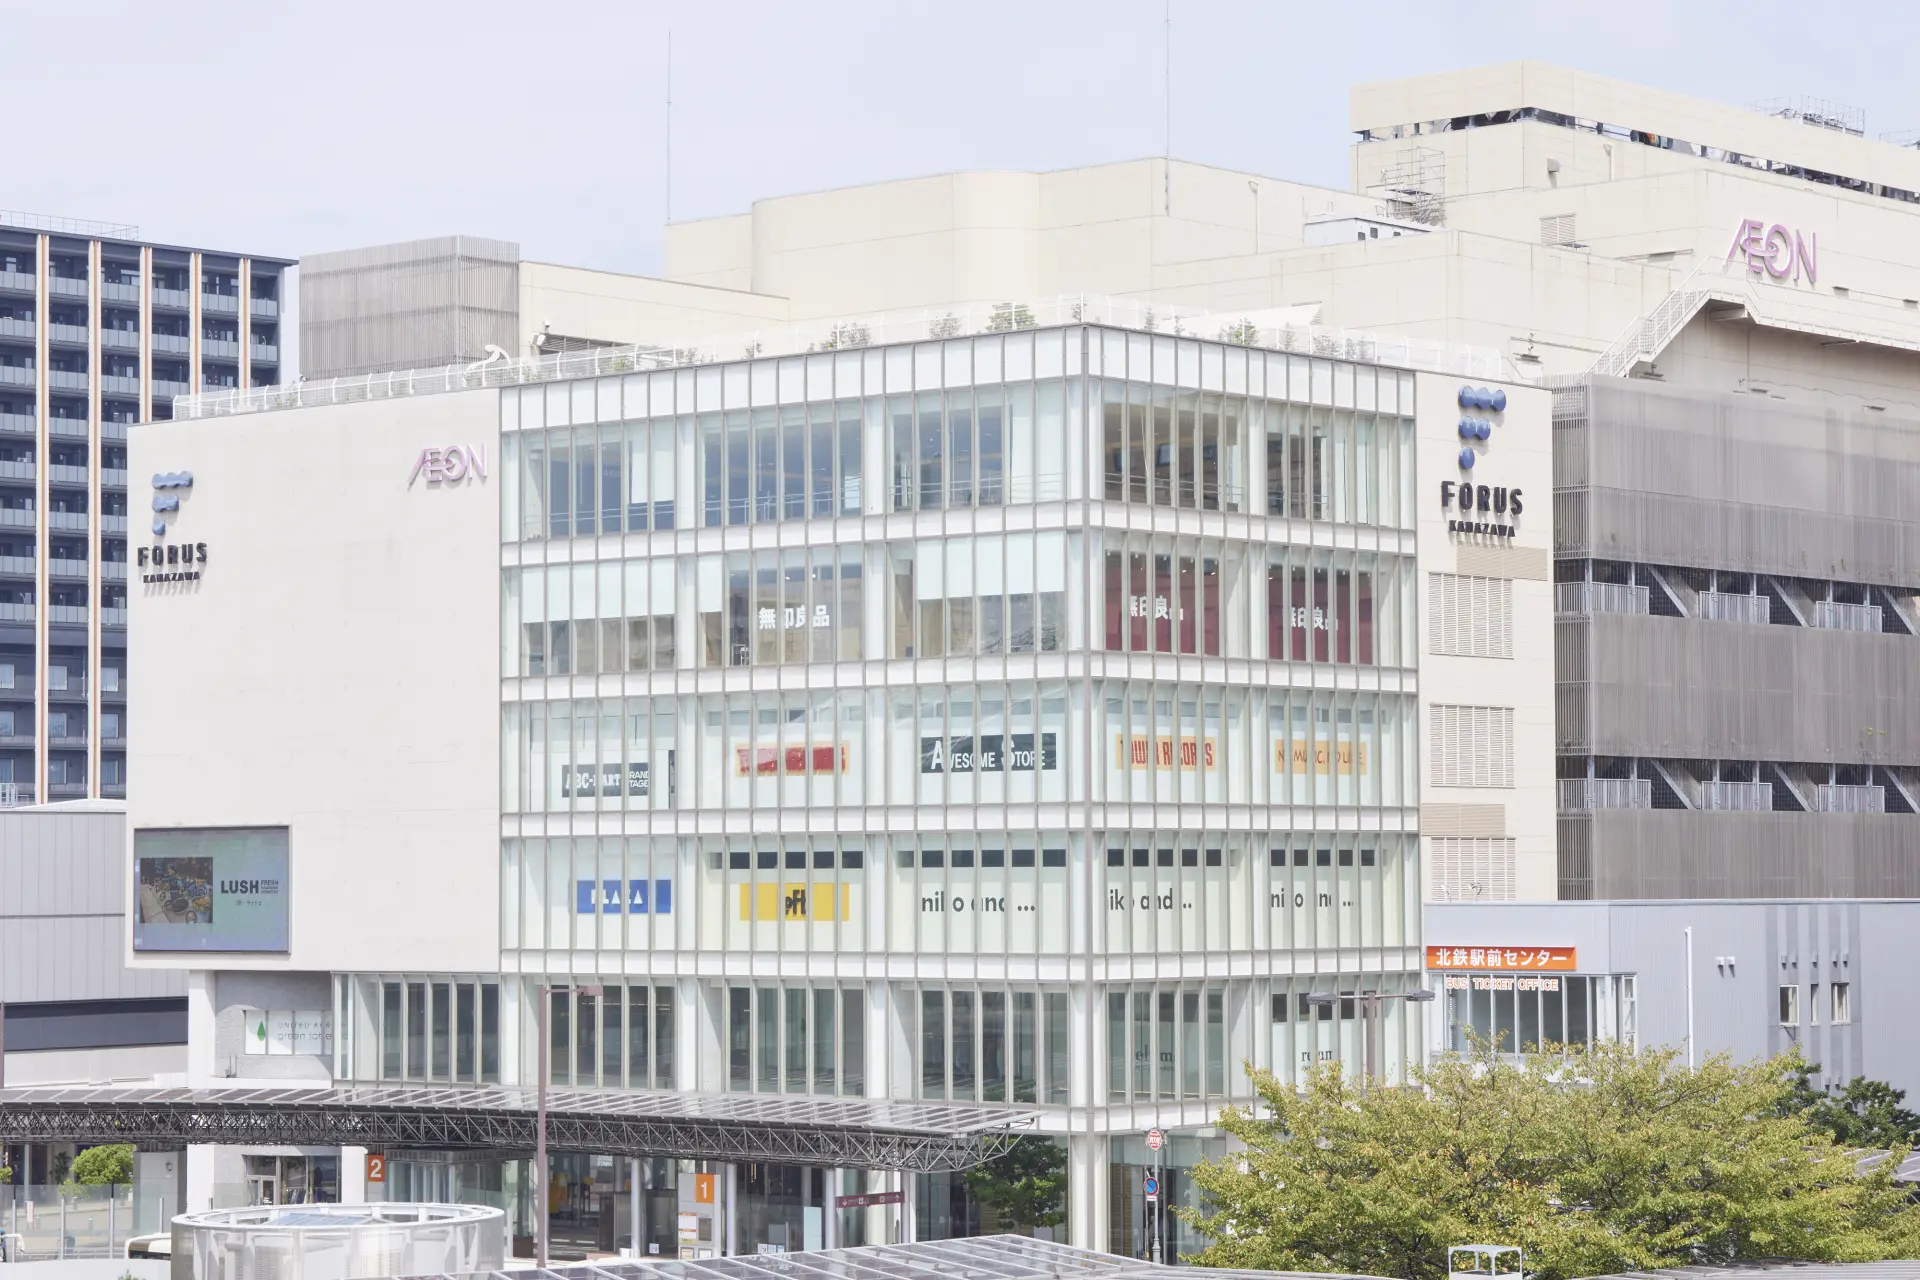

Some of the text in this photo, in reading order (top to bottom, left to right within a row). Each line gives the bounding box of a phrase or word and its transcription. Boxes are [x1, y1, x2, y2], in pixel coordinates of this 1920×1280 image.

[1441, 480, 1523, 515] FORUS
[1448, 519, 1516, 537] KANAZAWA
[137, 542, 208, 567] FORUS
[143, 571, 200, 583] KANAZAWA
[221, 879, 259, 894] LUSH
[1435, 947, 1568, 968] 北鉄駅前センター
[1446, 977, 1560, 992] BUS TICKET OFFICE
[370, 1159, 382, 1178] 2
[701, 1181, 708, 1199] 1
